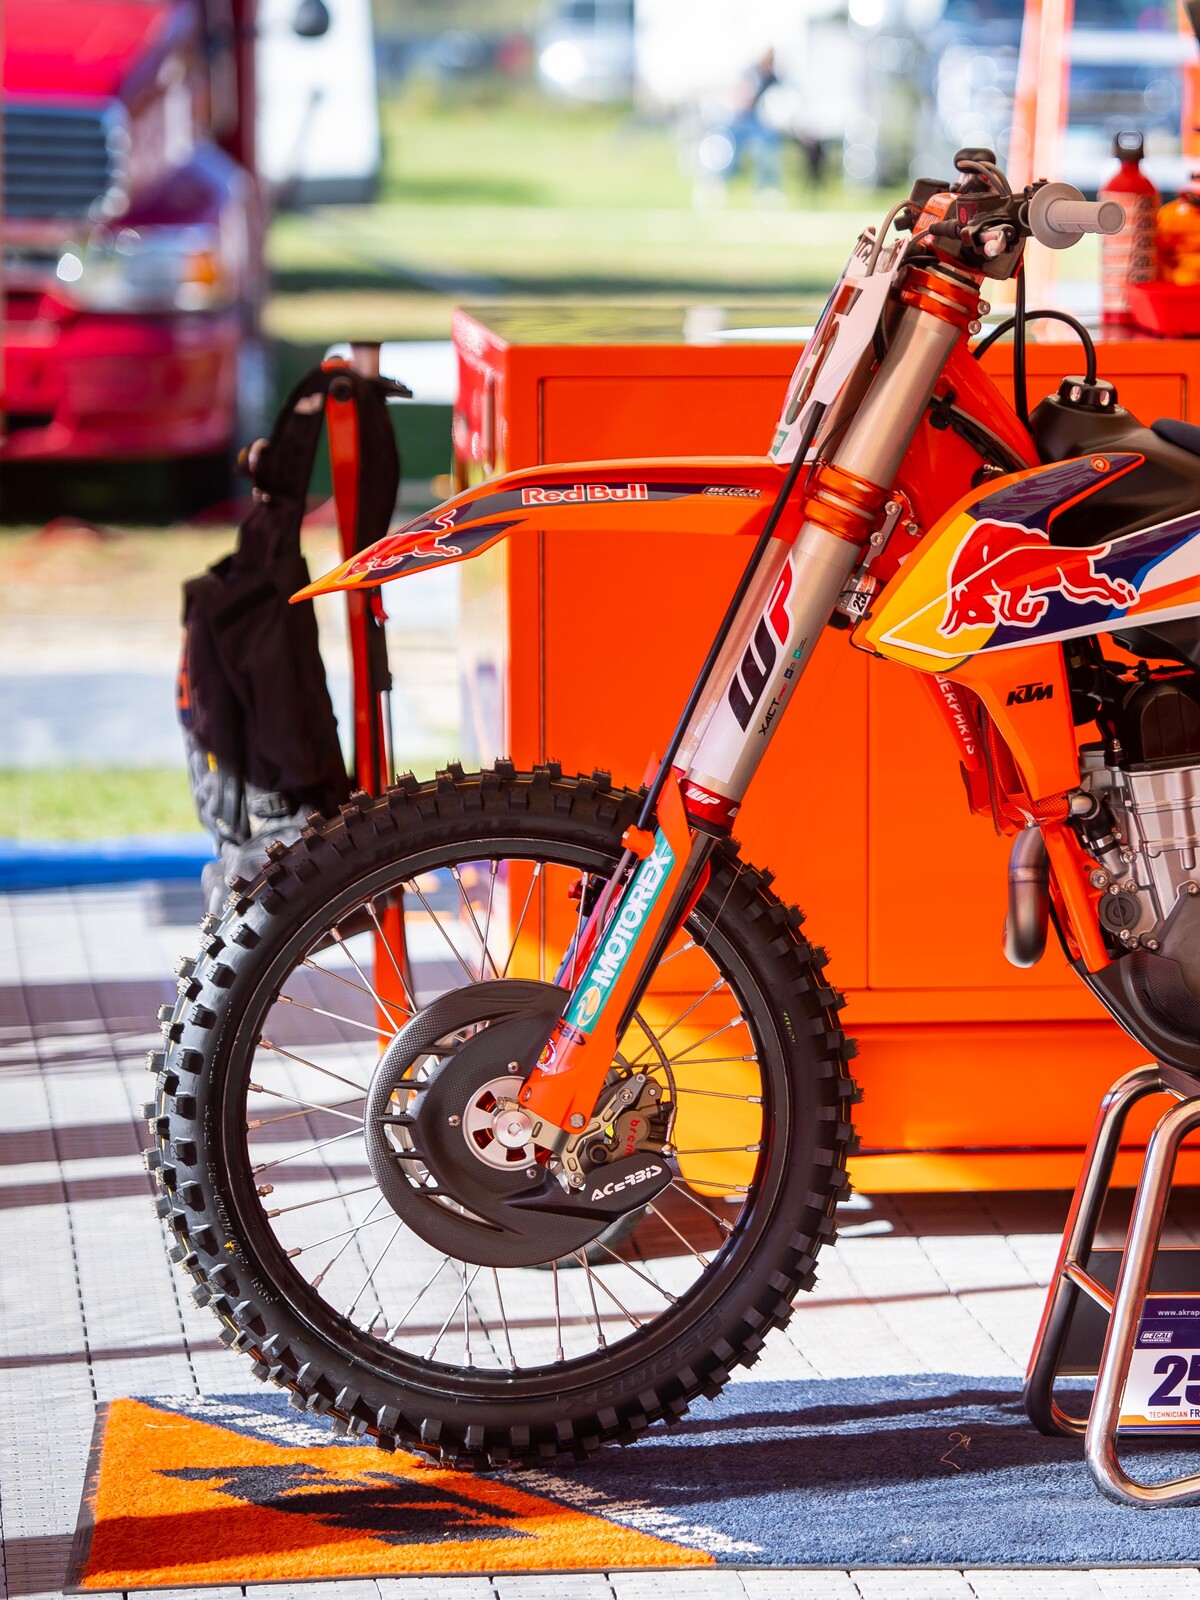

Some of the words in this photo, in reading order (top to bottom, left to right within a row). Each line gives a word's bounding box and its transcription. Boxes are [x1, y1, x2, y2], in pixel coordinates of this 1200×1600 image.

[522, 485, 584, 505] Red
[587, 484, 648, 500] Bull
[1006, 682, 1053, 706] KTM
[758, 697, 779, 736] XACT
[591, 849, 671, 987] MOTOREX
[591, 1164, 663, 1202] ACERBIS
